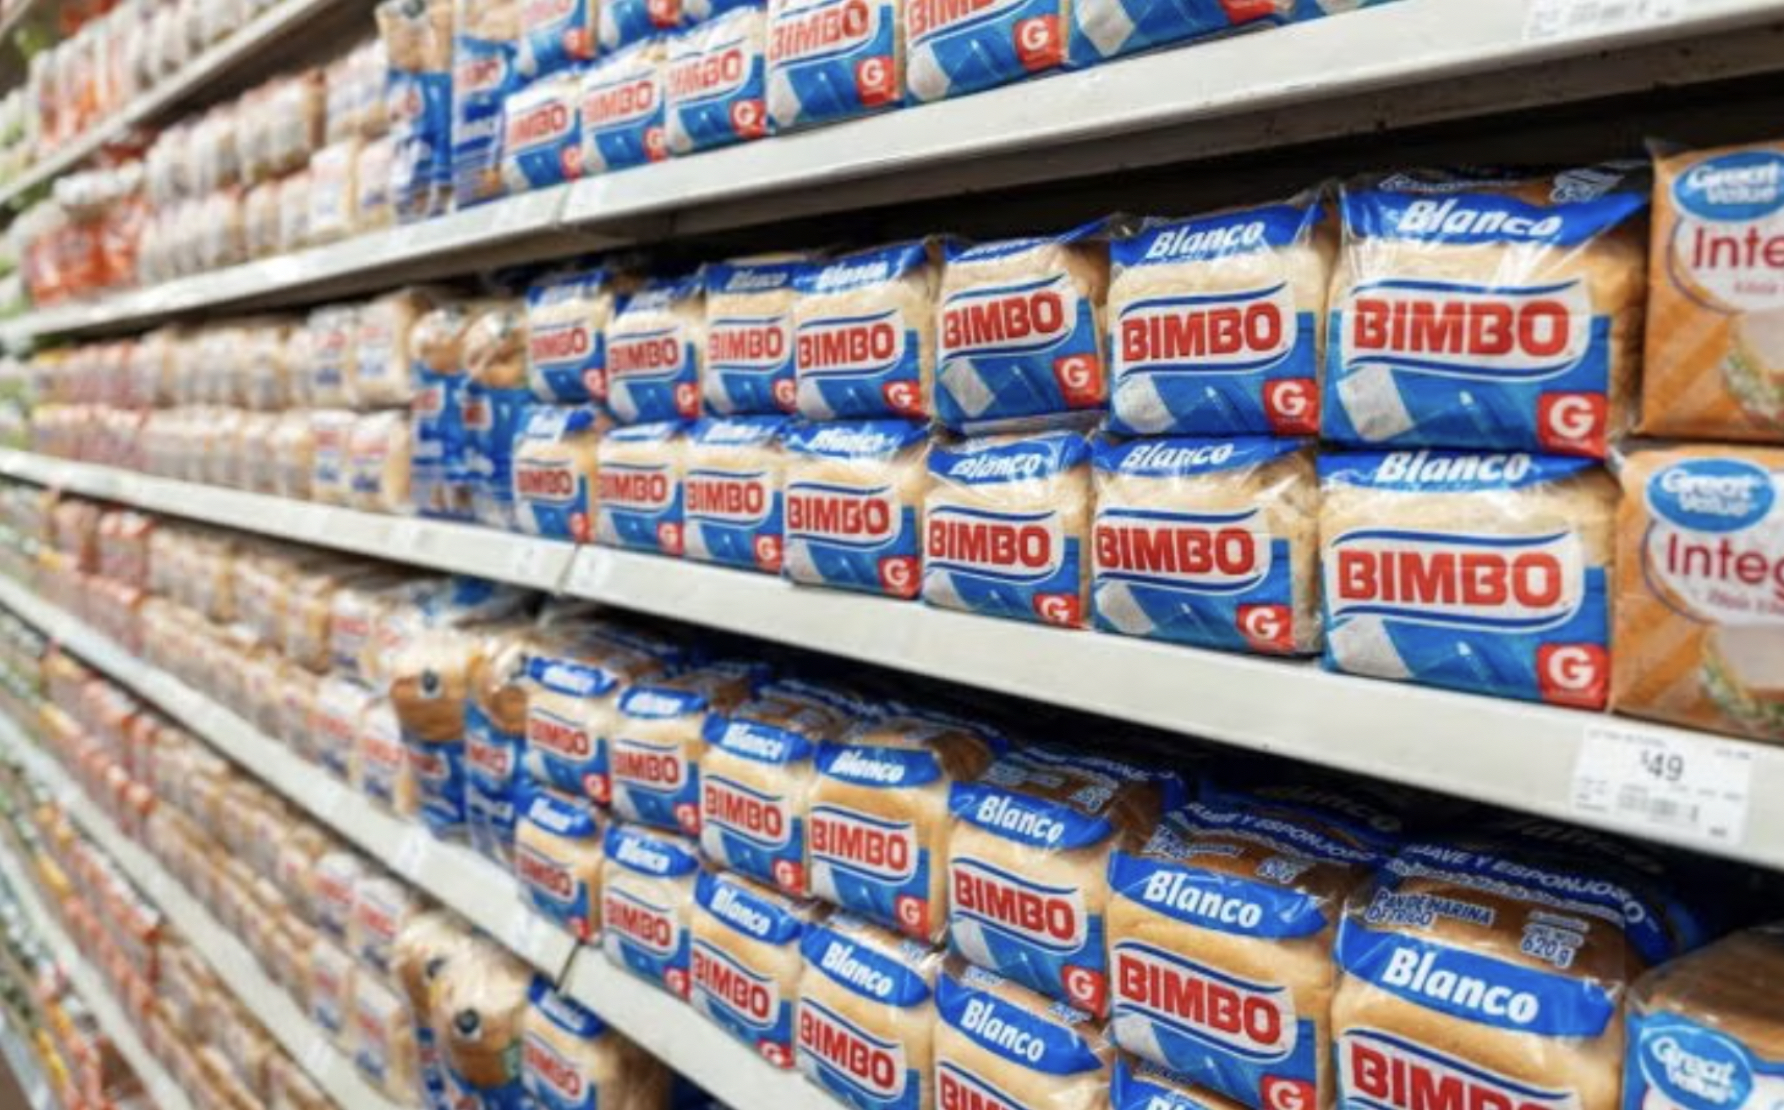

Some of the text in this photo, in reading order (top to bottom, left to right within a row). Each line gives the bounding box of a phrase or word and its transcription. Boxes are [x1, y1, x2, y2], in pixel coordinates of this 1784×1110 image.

[769, 0, 869, 61] BIMBO
[909, 0, 994, 37] BIM
[1022, 19, 1049, 50] G
[861, 58, 884, 86] G
[1398, 198, 1562, 236] Blanco
[1144, 221, 1265, 259] Blanco
[943, 291, 1065, 350] BIMBO
[1122, 301, 1283, 362] BIMBO
[1353, 299, 1570, 357] BIMBO
[609, 337, 679, 373] BIMBO
[708, 326, 785, 360] BIMBO
[797, 323, 896, 369] BIMBO
[1061, 357, 1090, 388] G
[888, 383, 912, 407] G
[1271, 381, 1307, 417] G
[1549, 394, 1595, 439] G
[1119, 441, 1235, 469] Blanco
[1374, 452, 1533, 483] Blanco
[597, 472, 669, 503] BIMBO
[687, 480, 765, 515] BIMBO
[787, 495, 891, 536] BIMBO
[928, 519, 1051, 568] BIMBO
[1095, 525, 1256, 576] BIMBO
[885, 558, 911, 586] G
[1337, 549, 1564, 608] BIMBO
[1041, 598, 1070, 624] G
[1246, 607, 1281, 640] G
[1548, 646, 1595, 689] G
[703, 784, 783, 838] BIMBO
[975, 795, 1065, 843] Blanco
[810, 815, 909, 872] BIMBO
[900, 901, 921, 927] G
[953, 869, 1077, 942] BIMBO
[1142, 868, 1263, 928] Blanco
[604, 897, 673, 949] BIMBO
[1522, 933, 1557, 957] 620
[692, 949, 771, 1020] BIMBO
[821, 939, 894, 997] Blanco
[1068, 971, 1096, 1000] G
[1382, 946, 1540, 1025] Blanco
[1118, 952, 1282, 1045] BIMBO
[799, 1008, 897, 1090] BIMBO
[960, 998, 1046, 1063] Blanco
[1270, 1080, 1304, 1110] G
[1351, 1040, 1550, 1110] BIM
